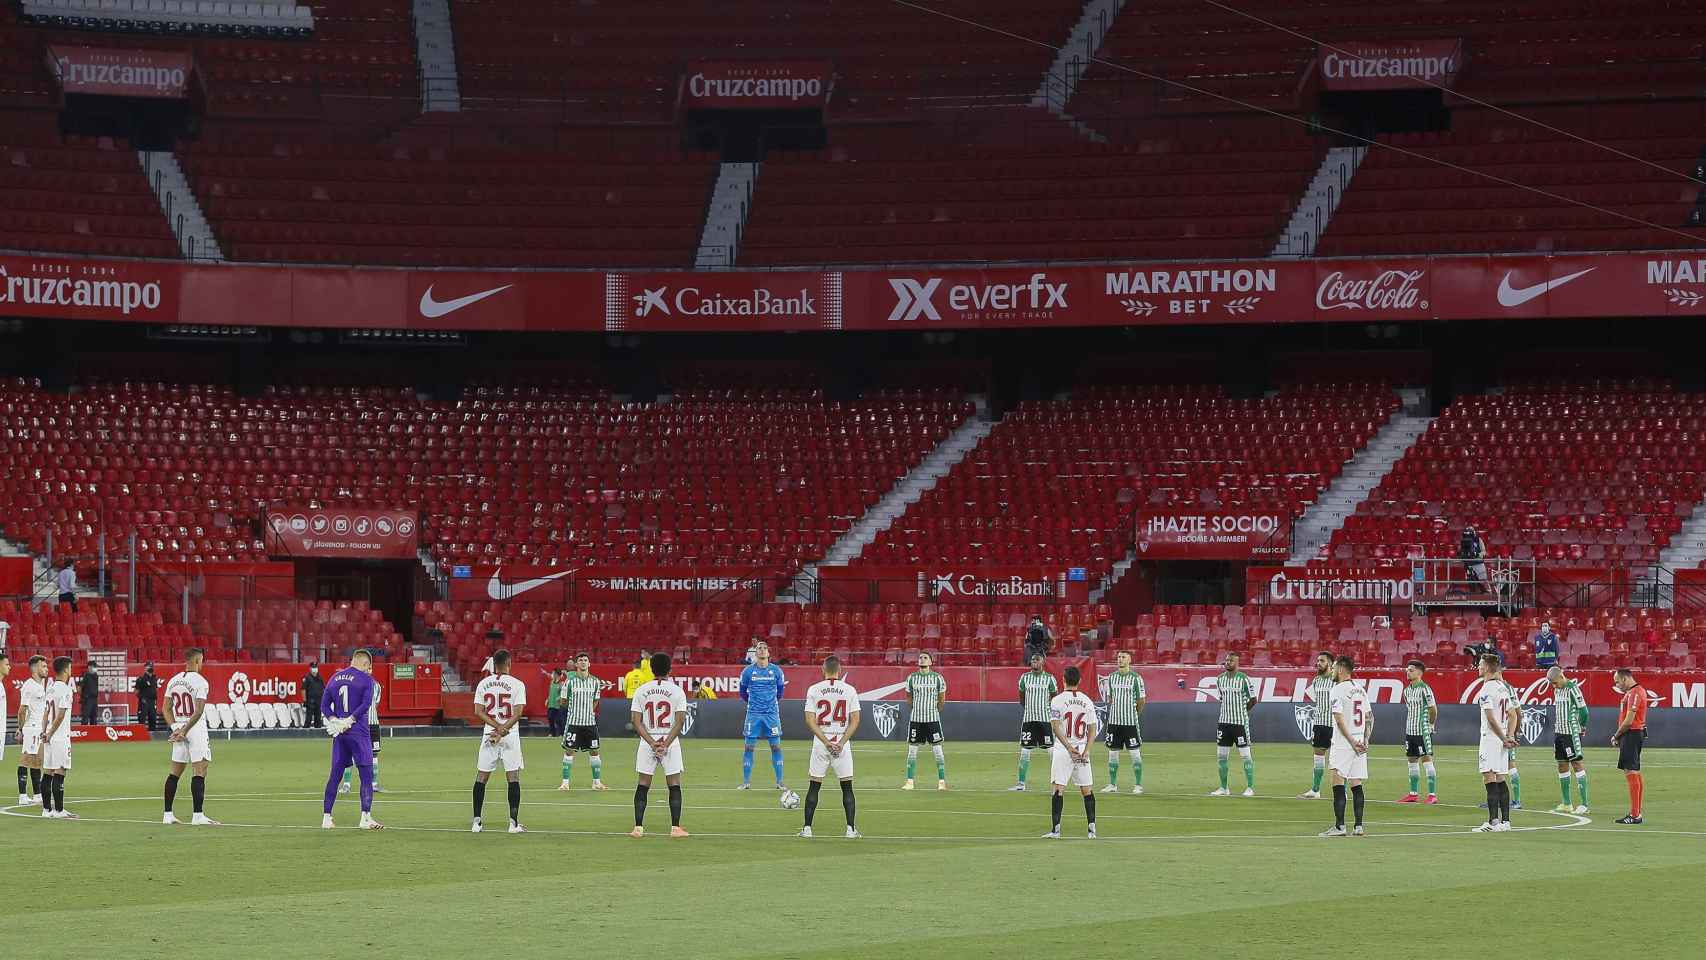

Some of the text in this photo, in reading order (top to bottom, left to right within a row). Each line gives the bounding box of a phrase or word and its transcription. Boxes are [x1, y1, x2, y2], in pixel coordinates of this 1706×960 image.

[56, 57, 186, 90] Cruzcampo
[1324, 53, 1456, 79] Cruzcampo
[690, 73, 821, 101] Cruzcampo
[949, 274, 1068, 310] everfx
[1106, 269, 1276, 295] MARATHON
[1316, 270, 1425, 310] Coca-Cola
[675, 287, 817, 316] CaixaBank
[1169, 299, 1211, 314] BET
[1147, 516, 1207, 536] ¡HAZTE
[1177, 535, 1209, 544] BECOME
[1209, 535, 1216, 543] A
[611, 578, 740, 591] MARATHONBET
[958, 574, 1055, 597] CaixaBank
[253, 677, 297, 699] LaLiga
[339, 685, 350, 713] 1
[171, 692, 195, 717] 20
[483, 693, 513, 719] 25
[645, 701, 671, 729] 12
[816, 699, 847, 727] 24
[1352, 700, 1364, 727] 5
[567, 733, 576, 742] 24
[911, 729, 917, 738] 5
[1022, 732, 1032, 741] 22
[1064, 711, 1087, 739] 16
